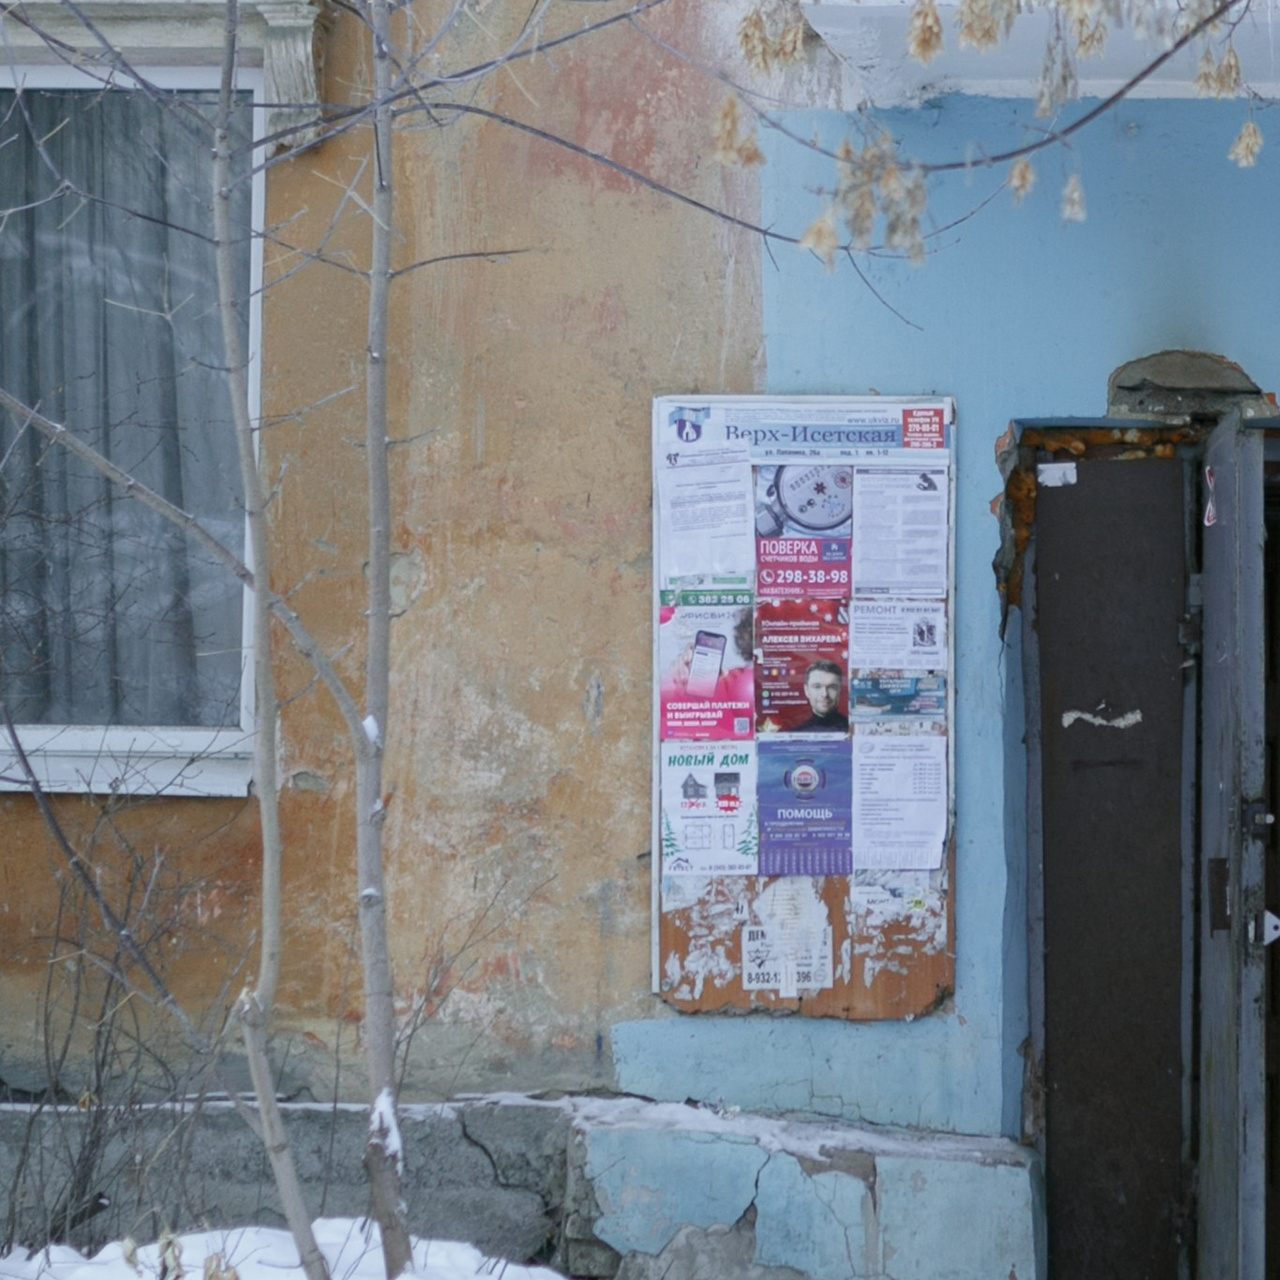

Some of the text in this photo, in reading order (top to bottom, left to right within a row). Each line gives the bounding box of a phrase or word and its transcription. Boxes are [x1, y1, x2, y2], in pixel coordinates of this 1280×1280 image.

[725, 425, 897, 446] Верх-Исетская
[760, 540, 818, 555] ПОВЕРКА
[776, 569, 849, 583] 298-38-98
[854, 605, 897, 615] РЕМОНТ
[666, 701, 710, 710] СОВЕРШАЙ
[668, 752, 750, 768] НОВЫЙ ДОМ
[777, 808, 833, 820] ПОМОЩЬ
